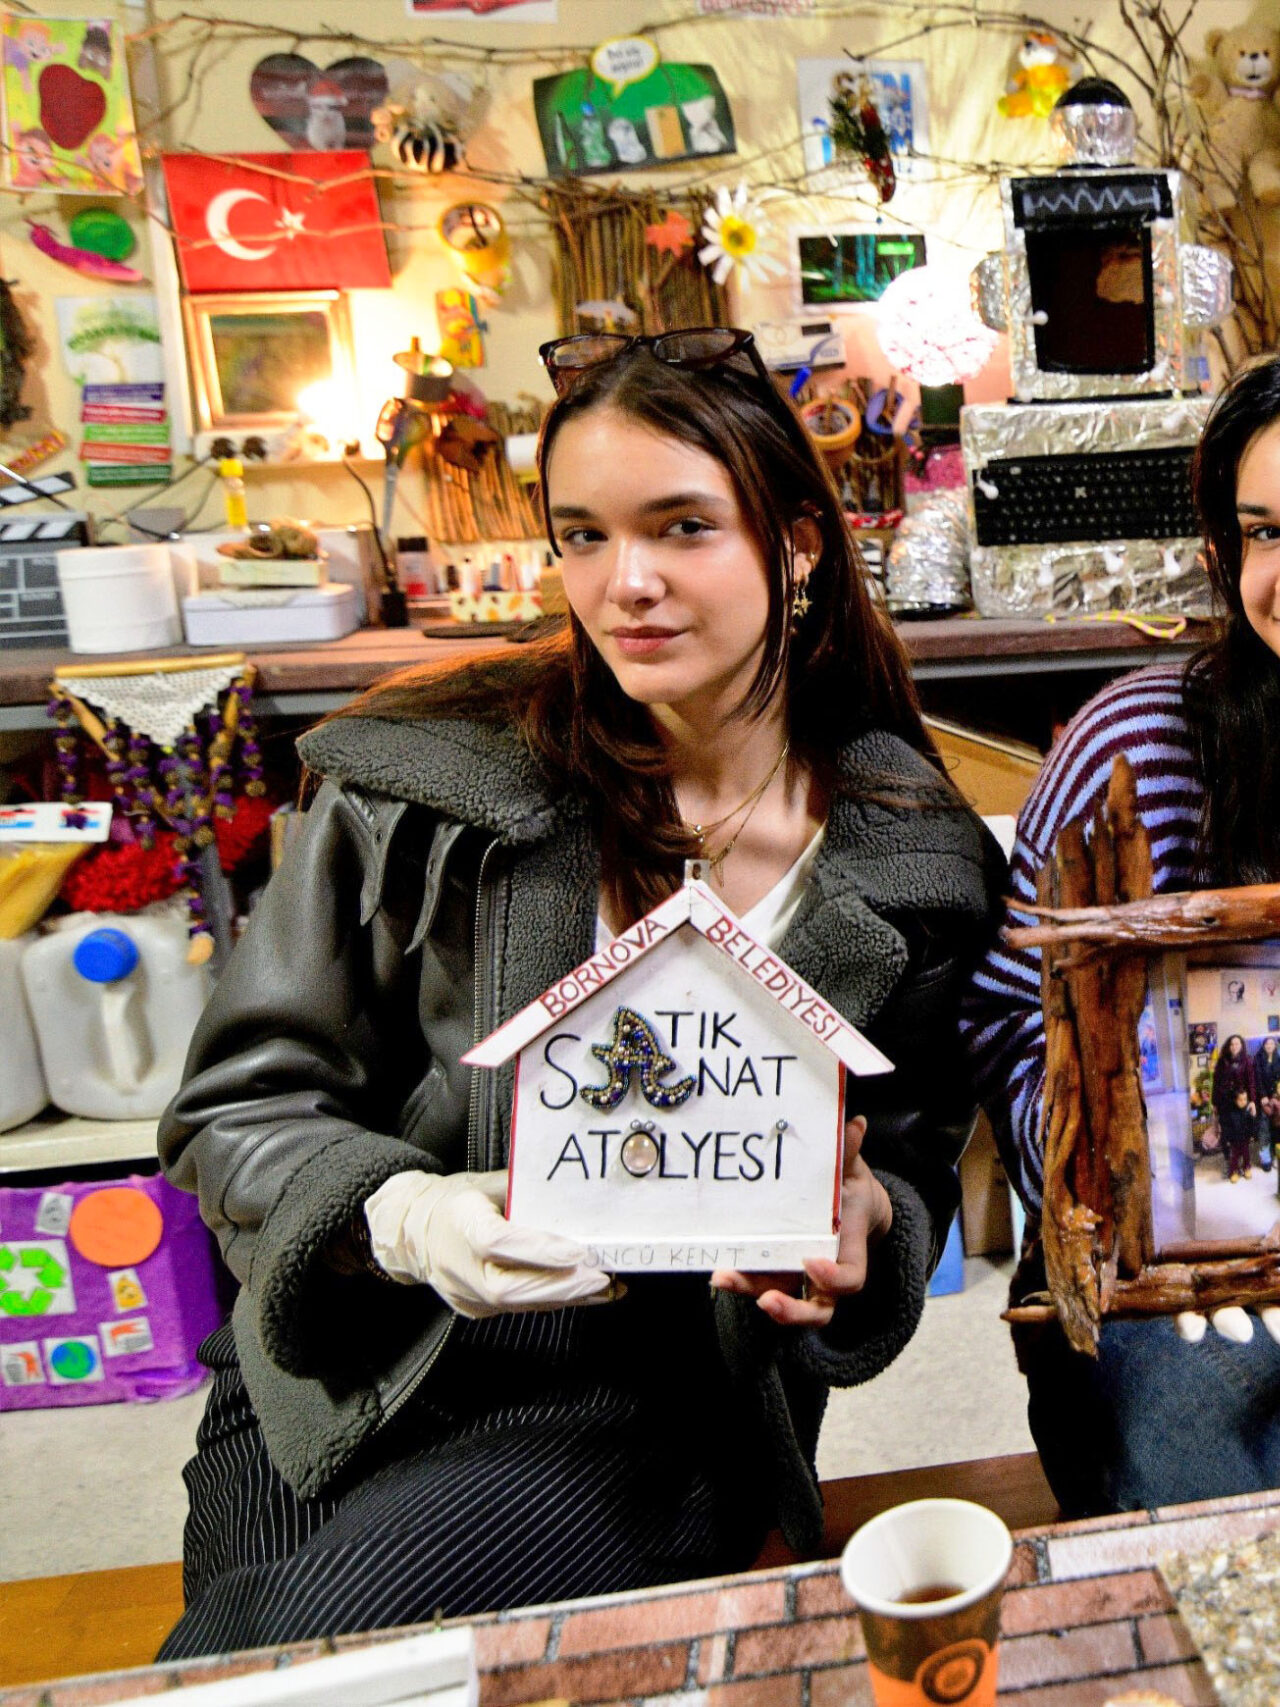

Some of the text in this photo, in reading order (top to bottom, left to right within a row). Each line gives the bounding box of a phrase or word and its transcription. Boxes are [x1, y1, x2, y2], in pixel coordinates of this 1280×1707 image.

[540, 918, 668, 1018] BORNOVA
[705, 916, 847, 1042] BELEDİYESİ
[547, 1119, 789, 1181] ATÖLYESİ
[671, 1247, 746, 1267] KENT
